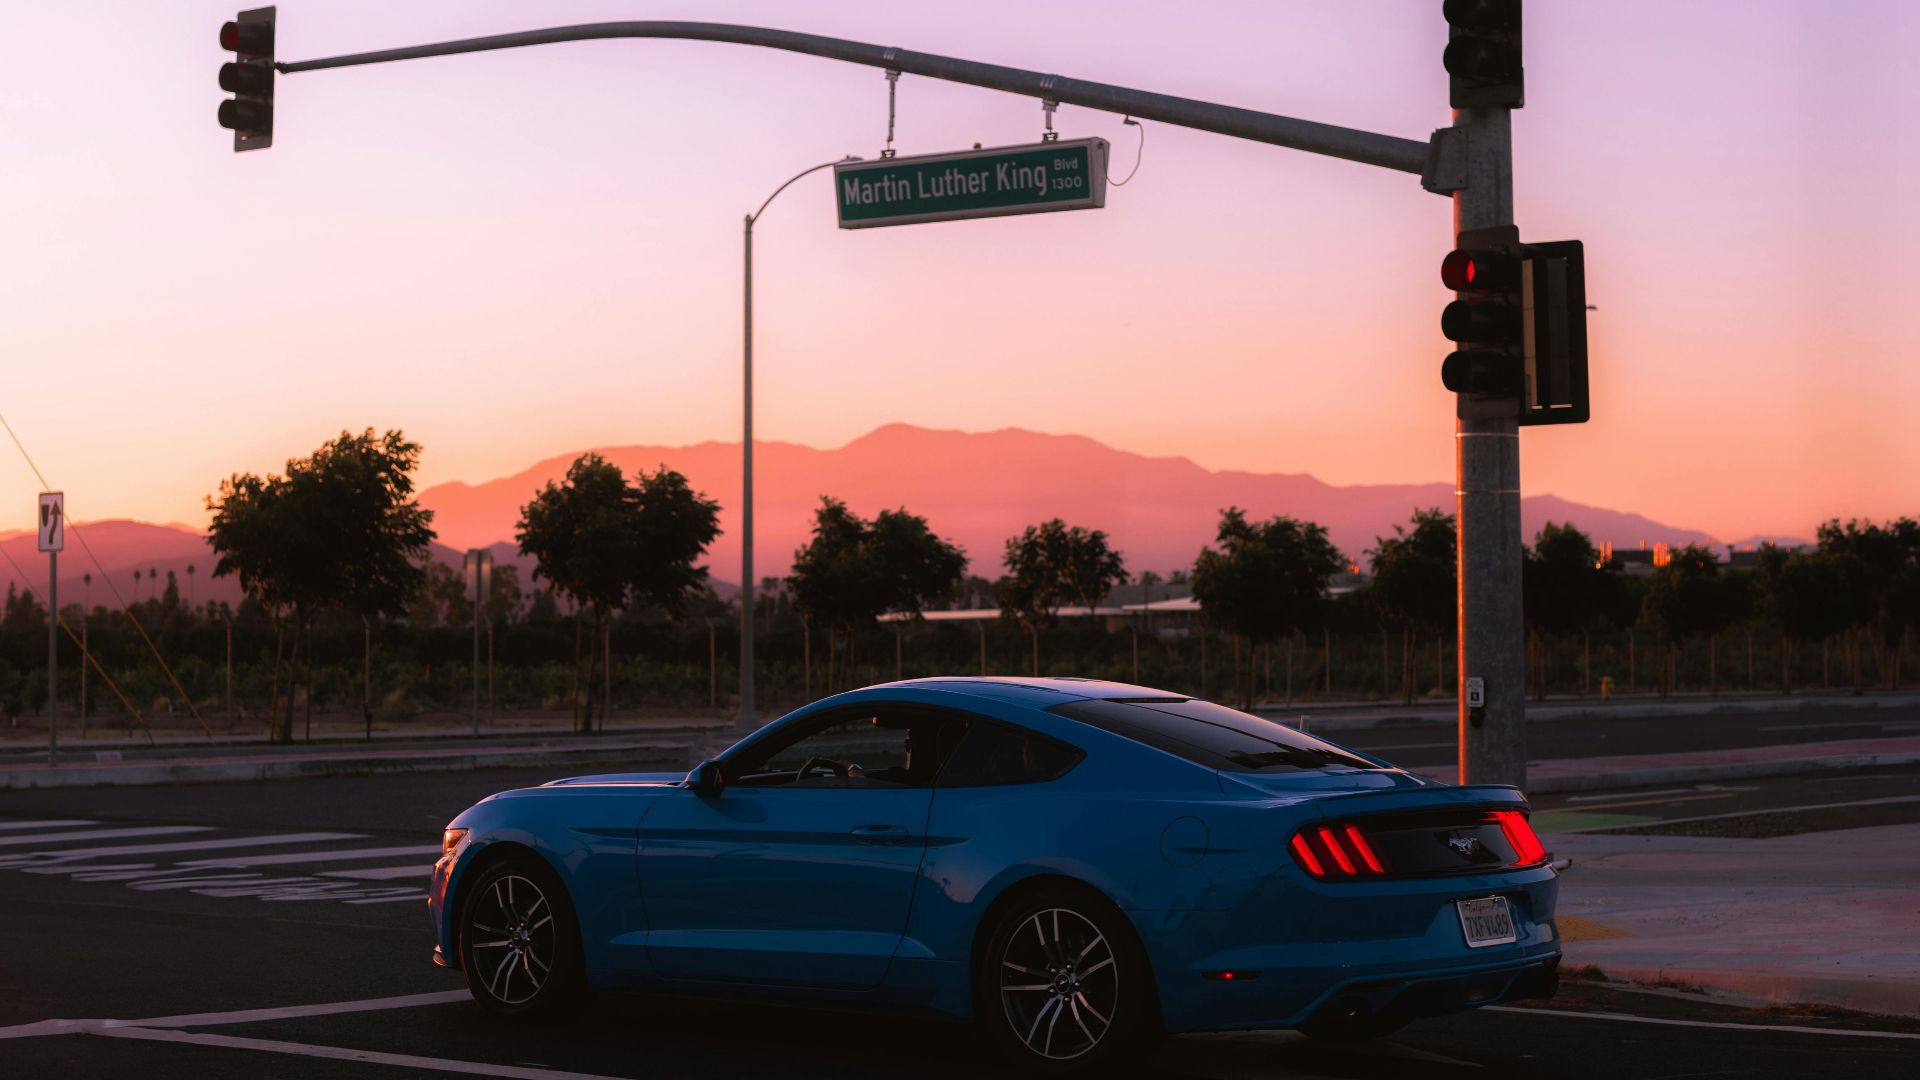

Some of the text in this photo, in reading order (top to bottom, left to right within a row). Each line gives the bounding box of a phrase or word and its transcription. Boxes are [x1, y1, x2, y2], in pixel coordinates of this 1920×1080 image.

[1054, 157, 1078, 171] Blvd
[844, 162, 1047, 206] Martin Luther King
[1051, 175, 1082, 190] 1300
